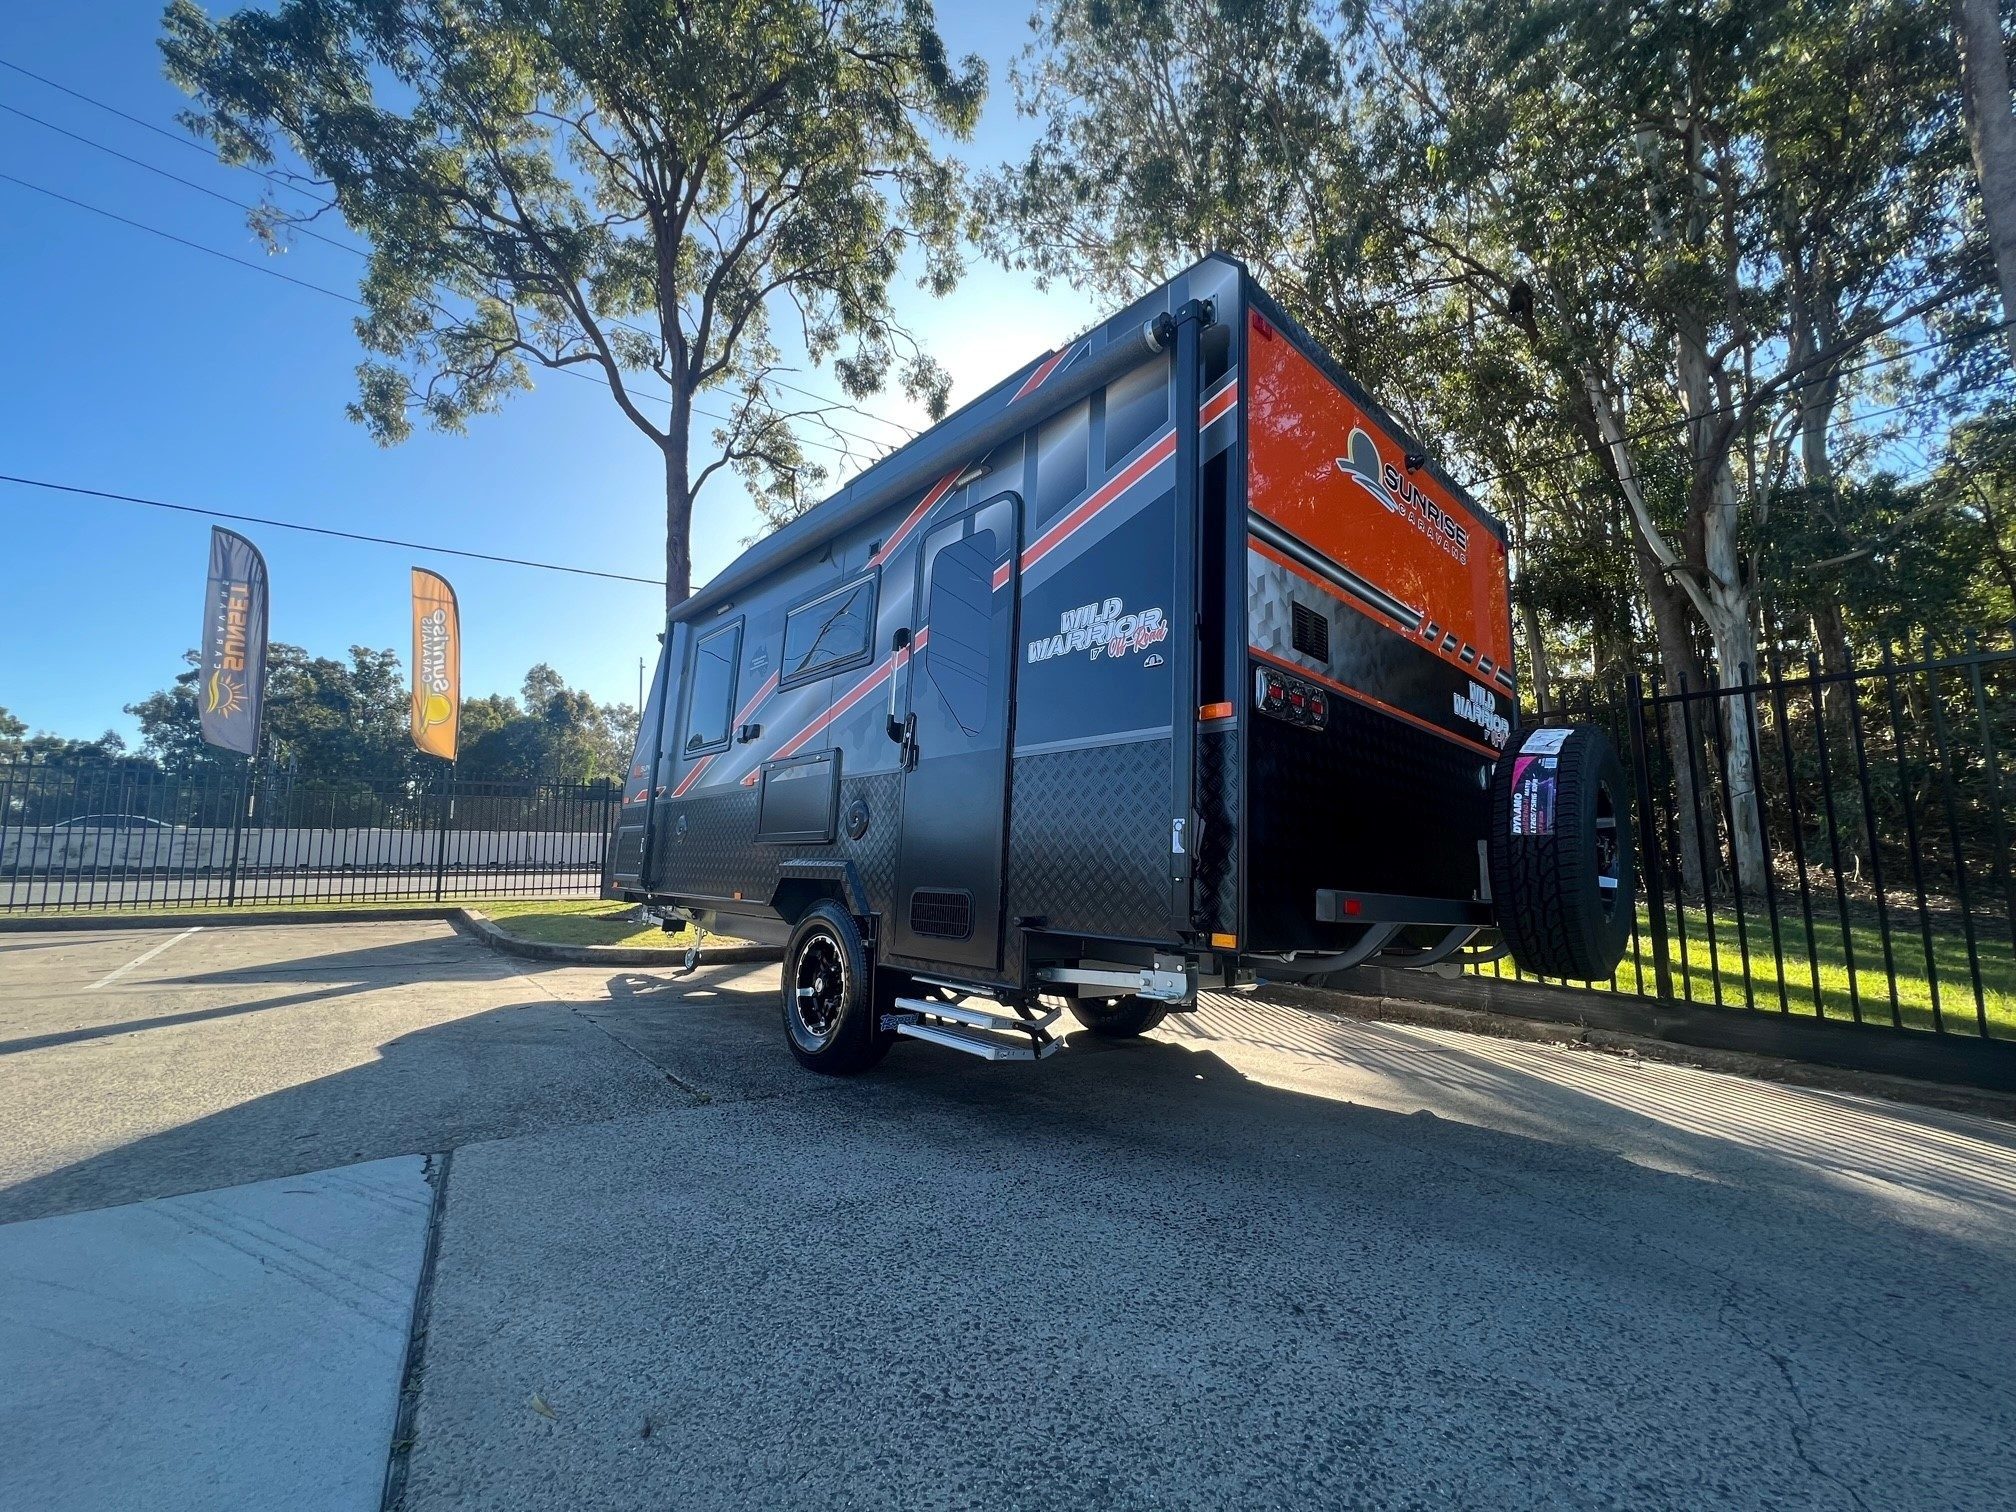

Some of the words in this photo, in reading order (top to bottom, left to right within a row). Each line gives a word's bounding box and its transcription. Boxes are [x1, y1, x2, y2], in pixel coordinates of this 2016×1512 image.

[1384, 463, 1468, 551] SUNRISE
[1398, 503, 1467, 565] CARAVANS
[1028, 607, 1162, 664] WARRIOR
[1061, 597, 1123, 634] WILD
[1453, 692, 1510, 738] WARRIOR
[1469, 680, 1496, 713] WILD
[1513, 793, 1522, 834] DYNAMO
